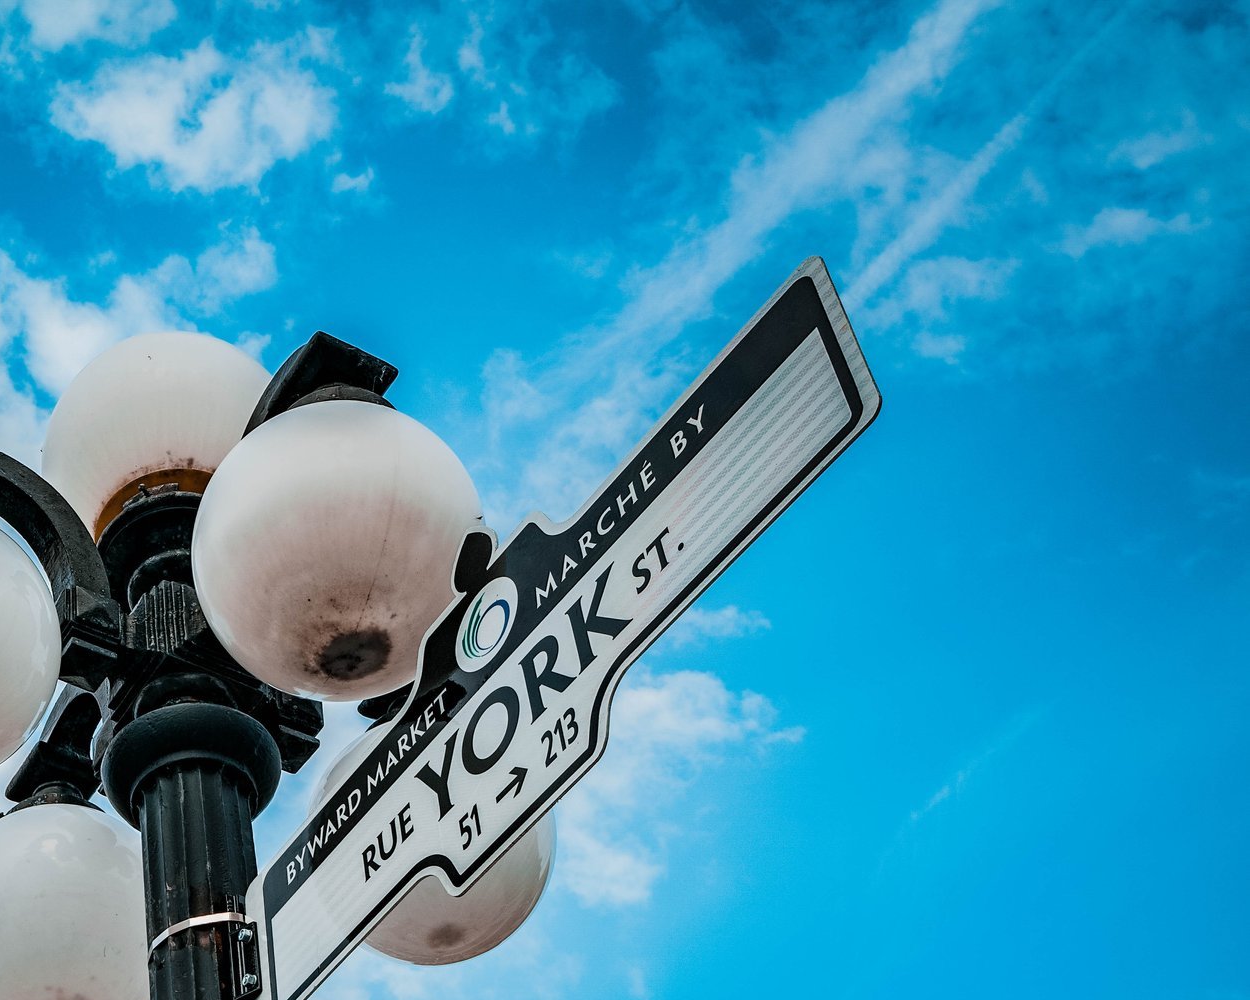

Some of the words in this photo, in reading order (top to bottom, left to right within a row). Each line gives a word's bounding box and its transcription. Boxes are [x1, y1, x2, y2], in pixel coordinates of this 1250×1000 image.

[535, 460, 657, 609] MARCHÉ
[669, 404, 705, 460] BY
[286, 788, 361, 886] BYWARD
[366, 688, 448, 796] MARKET
[361, 803, 415, 883] RUE
[414, 561, 634, 822] YORK
[631, 528, 686, 594] ST.
[459, 804, 482, 850] 51
[541, 707, 580, 767] 213
